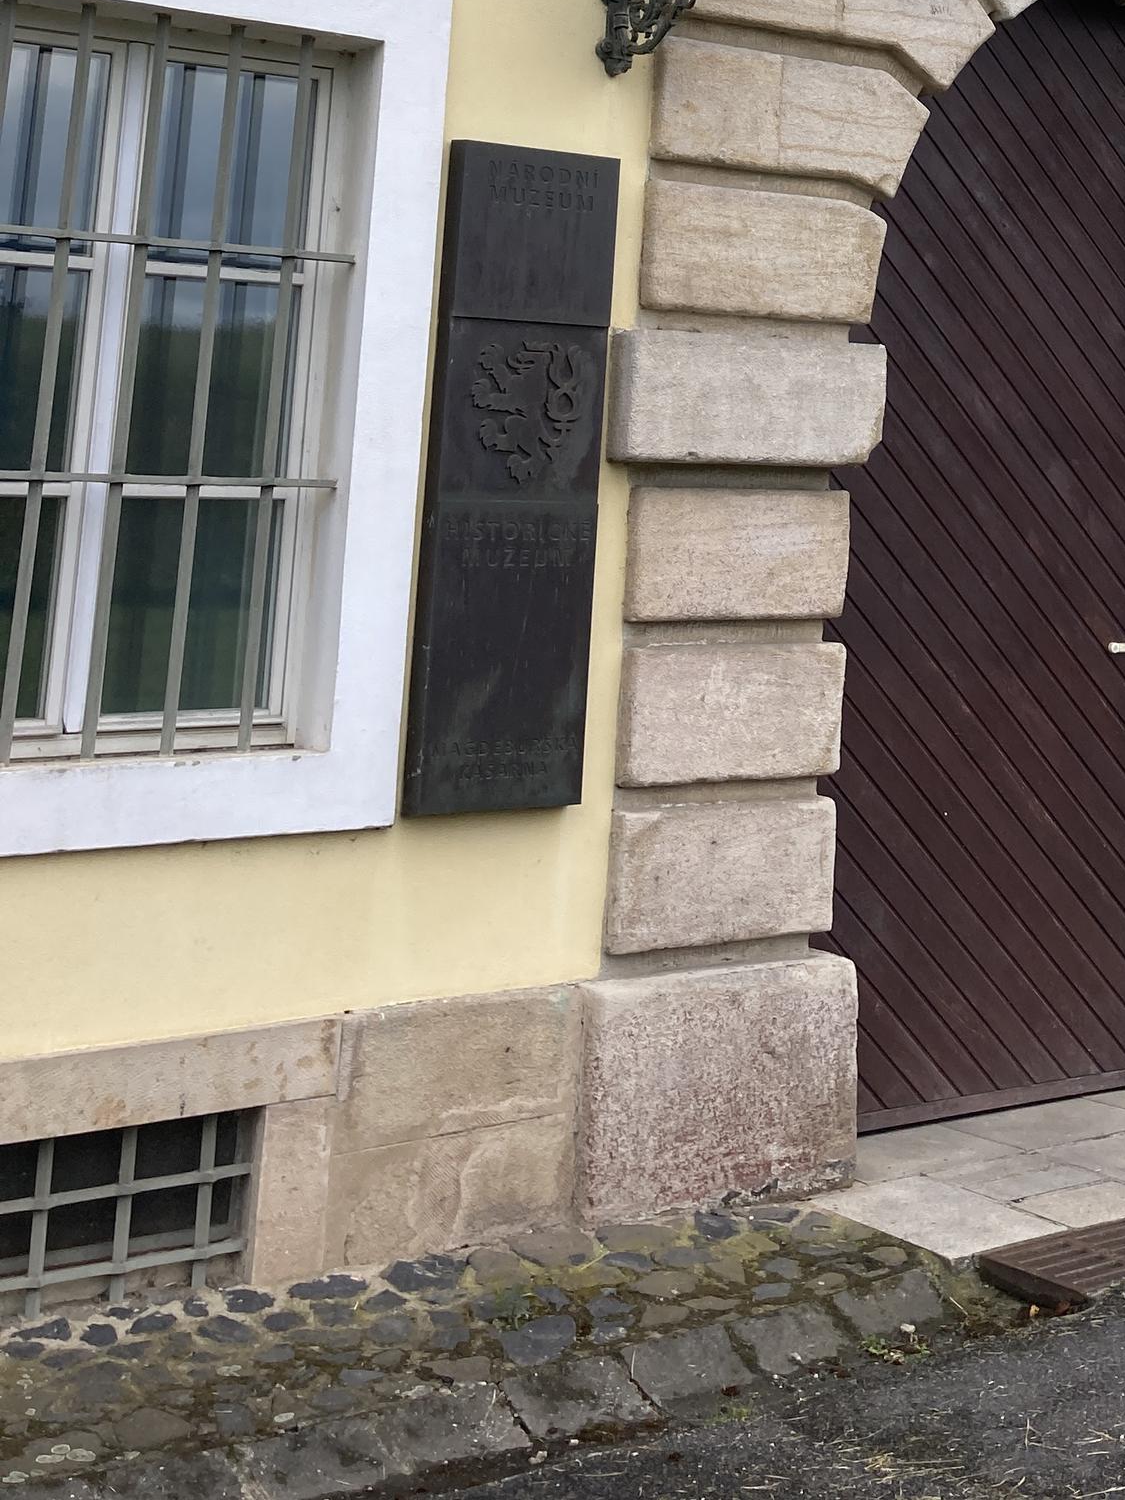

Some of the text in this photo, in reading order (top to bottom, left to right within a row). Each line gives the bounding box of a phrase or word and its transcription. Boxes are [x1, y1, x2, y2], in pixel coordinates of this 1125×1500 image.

[488, 159, 598, 189] NÁRODNÍ
[489, 184, 594, 211] MUZEUM
[462, 549, 572, 567] MUZEUM
